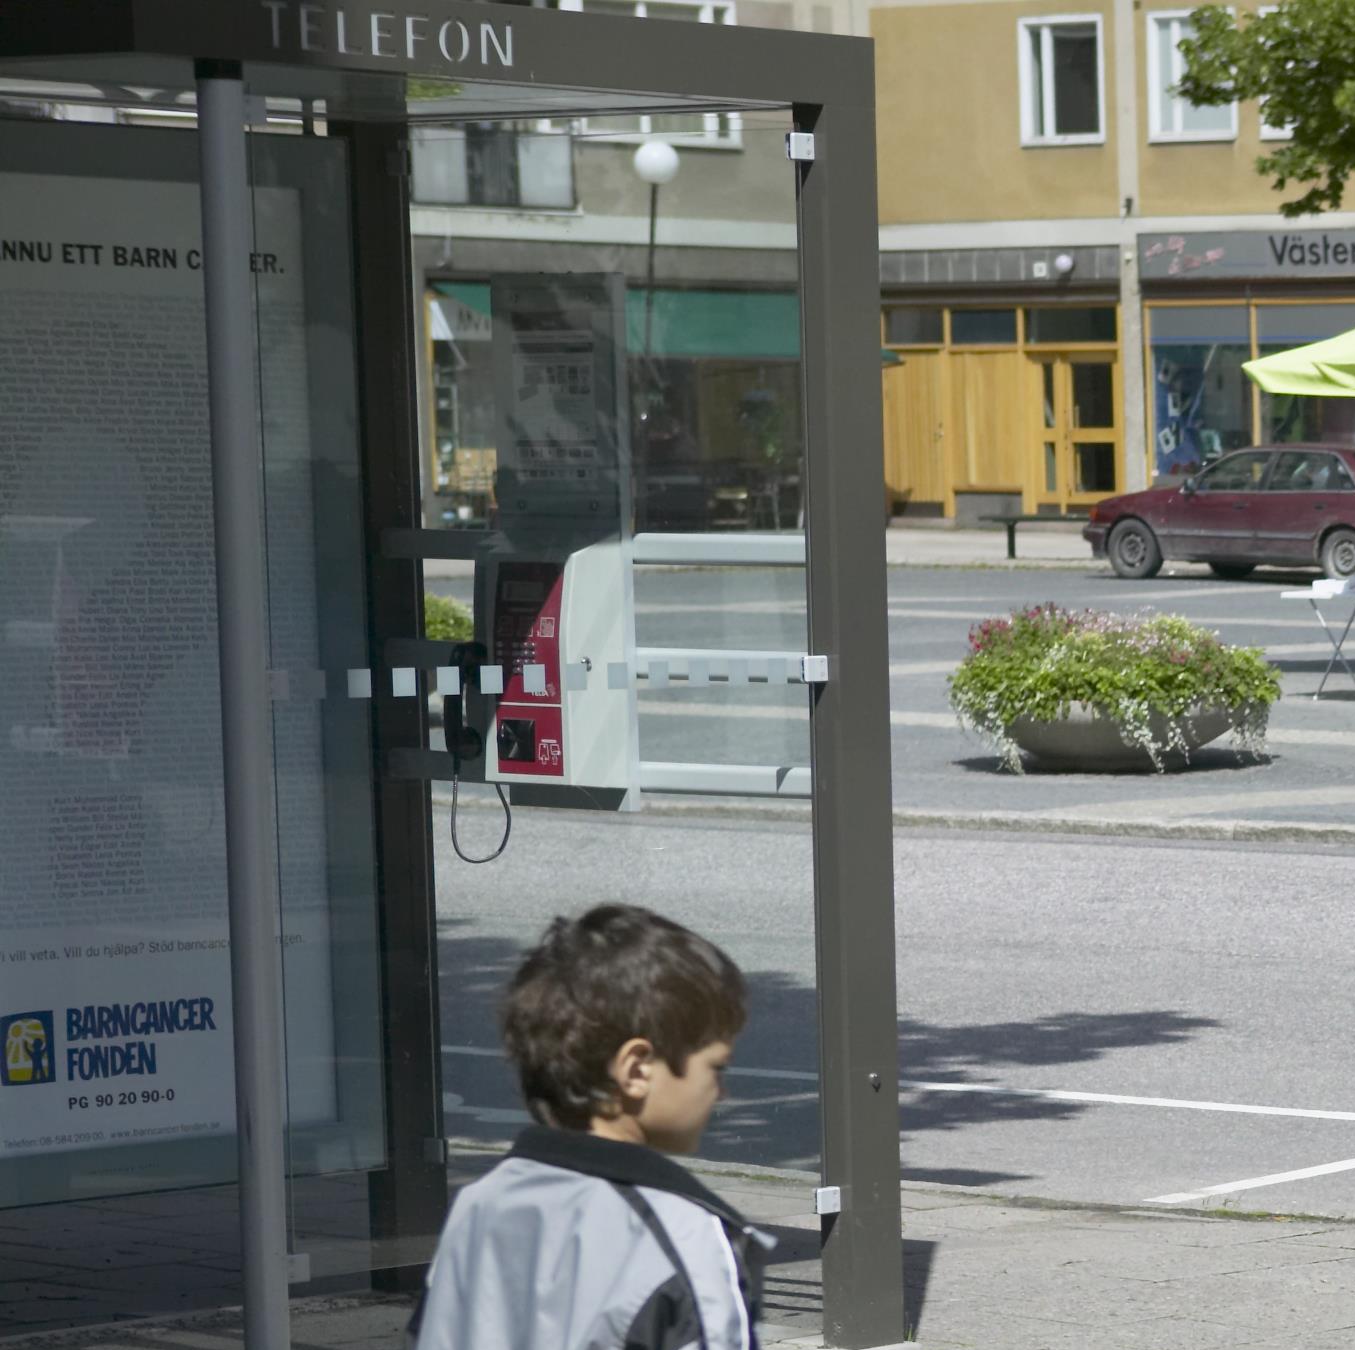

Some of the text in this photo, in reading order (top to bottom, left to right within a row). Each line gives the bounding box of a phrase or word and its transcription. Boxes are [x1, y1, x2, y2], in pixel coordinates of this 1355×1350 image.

[261, 2, 513, 66] TELEFON
[0, 239, 286, 275] NNU ETT BARN CER.
[9, 949, 27, 962] vill
[31, 948, 60, 962] veta.
[64, 947, 82, 959] Vill
[86, 945, 100, 958] du
[103, 942, 145, 959] hjälpa?
[148, 940, 174, 953] Stöd
[66, 997, 217, 1041] BARNCANCER
[67, 1041, 157, 1081] FONDEN
[68, 1088, 175, 1110] PG 90 20 90-0
